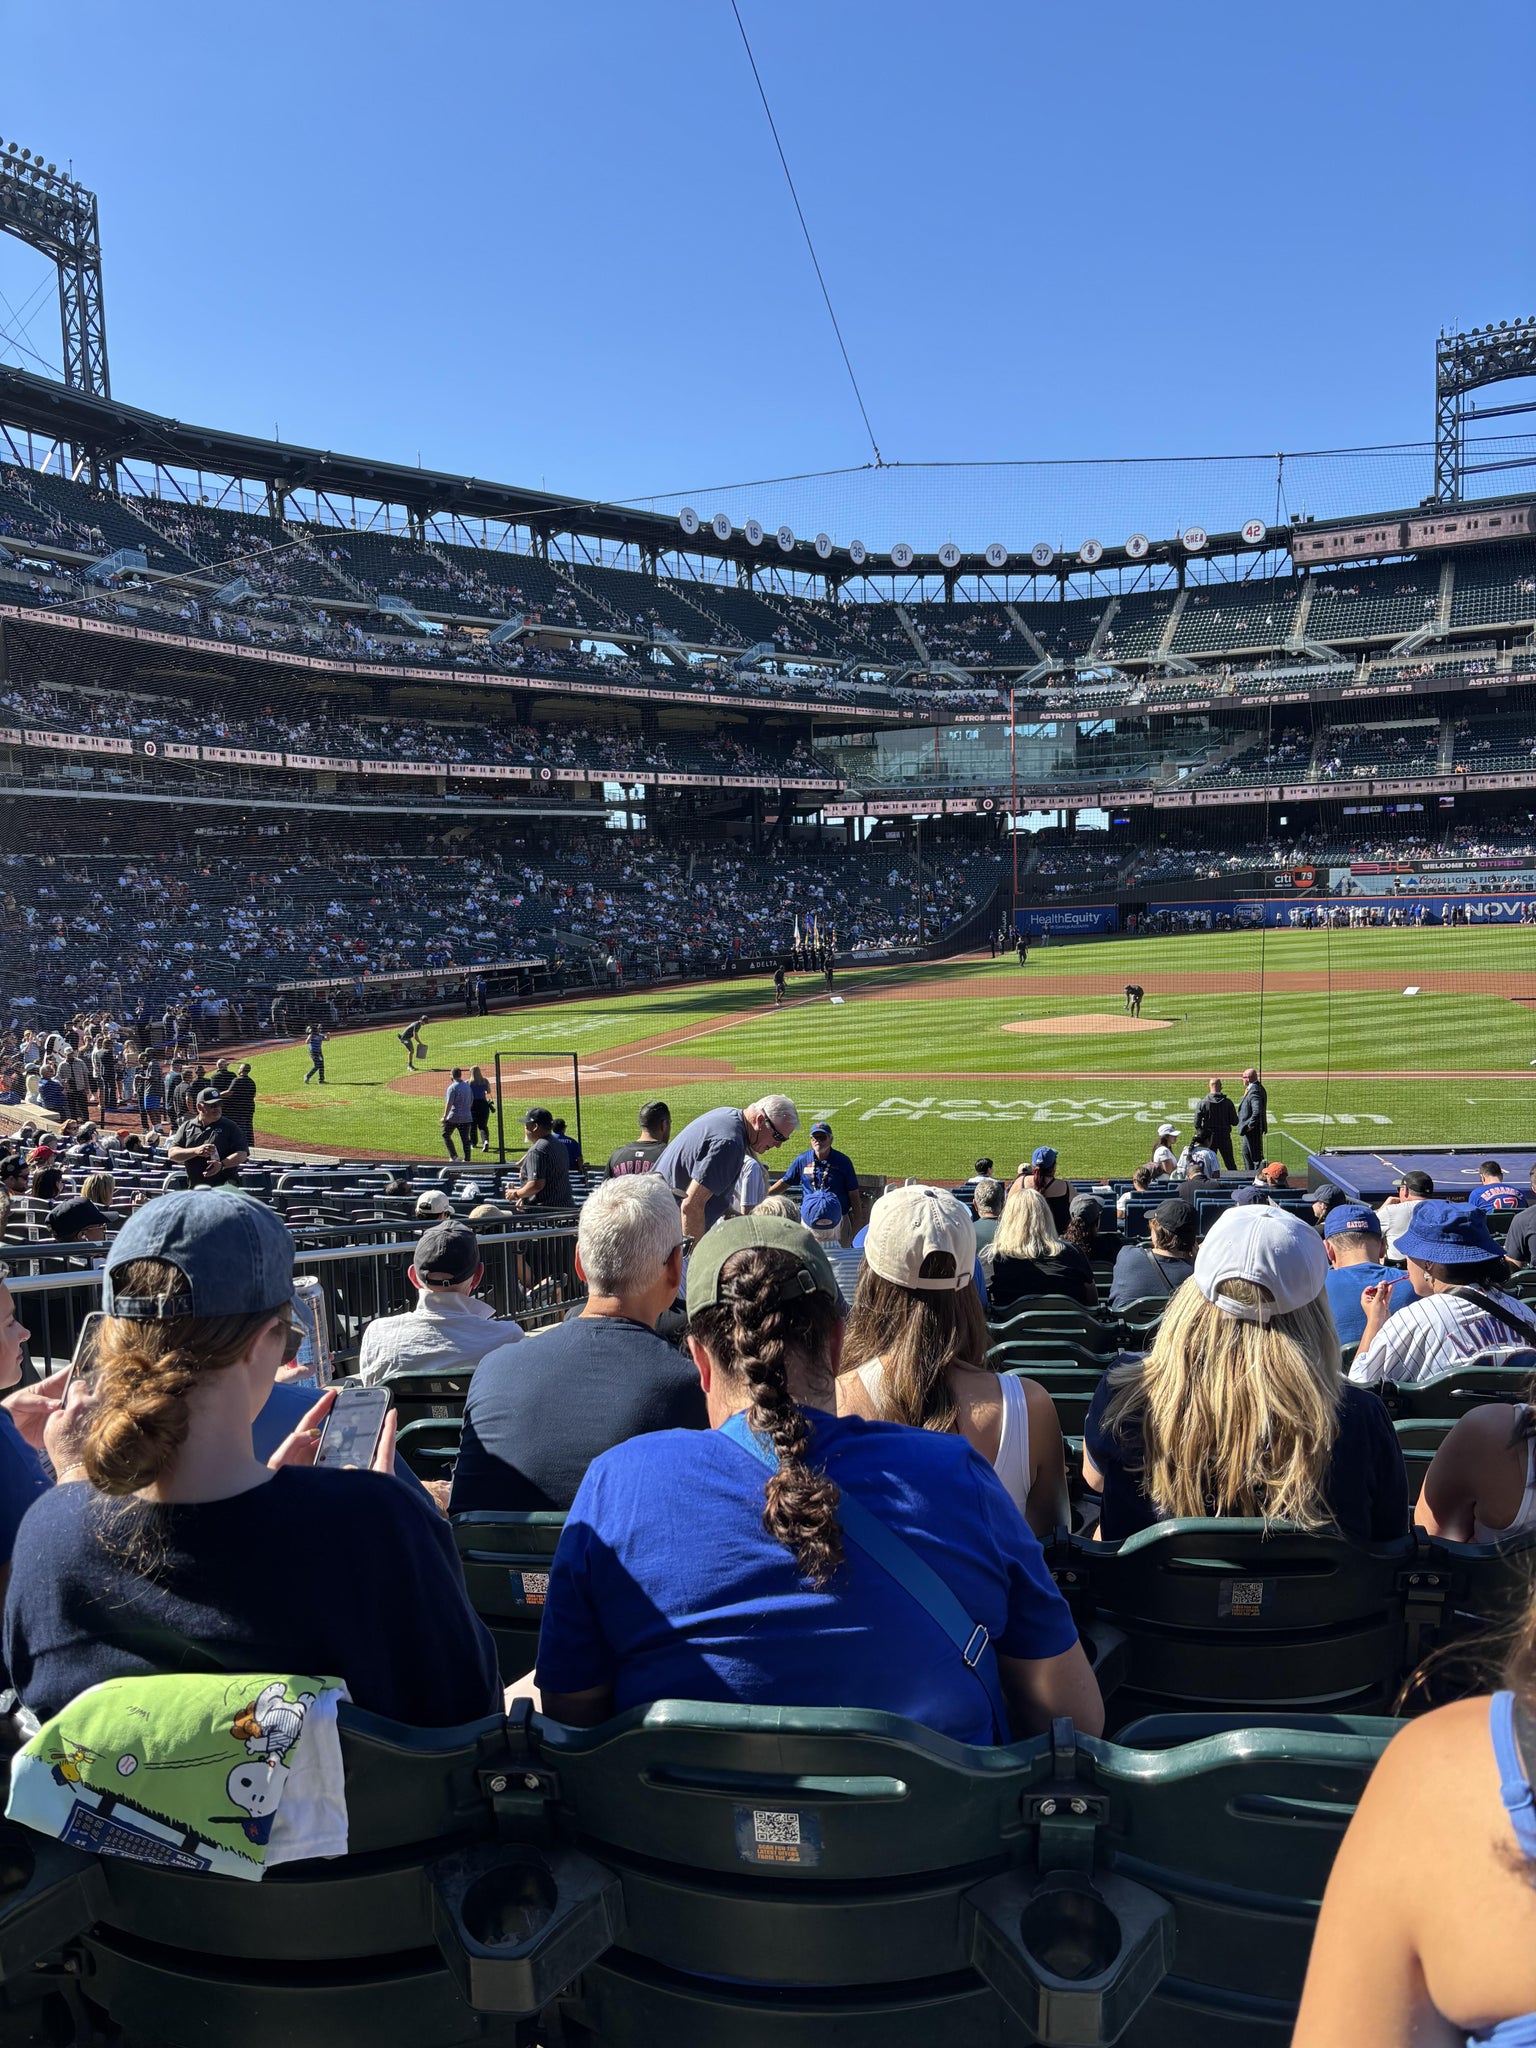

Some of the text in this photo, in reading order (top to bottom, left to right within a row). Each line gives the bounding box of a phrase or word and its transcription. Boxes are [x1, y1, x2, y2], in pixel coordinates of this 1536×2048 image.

[686, 515, 693, 528] 5
[717, 521, 727, 533] 18
[749, 527, 758, 539] 16
[1246, 525, 1260, 538] 42
[780, 533, 792, 545] 24
[1185, 532, 1204, 545] SHEA
[819, 540, 827, 551] 17
[853, 546, 863, 558] 36
[897, 549, 908, 561] 31
[944, 549, 954, 561] 41
[991, 550, 1001, 561] 14
[1036, 549, 1049, 561] 37
[1469, 676, 1509, 686] ASTROS
[1341, 684, 1412, 696] ASTROS METS
[1284, 692, 1310, 701] METS
[1147, 700, 1211, 713] ASTROS METS
[954, 714, 985, 722] ASTROS
[1039, 710, 1099, 720] ASTROS METS
[1422, 862, 1464, 870] WELCOME
[1301, 872, 1313, 880] 79
[1418, 875, 1446, 884] Coors
[1447, 876, 1474, 884] LIGHT
[1030, 912, 1100, 924] HealthEquity
[1494, 1198, 1518, 1209] 17
[1447, 1315, 1530, 1358] LINDO
